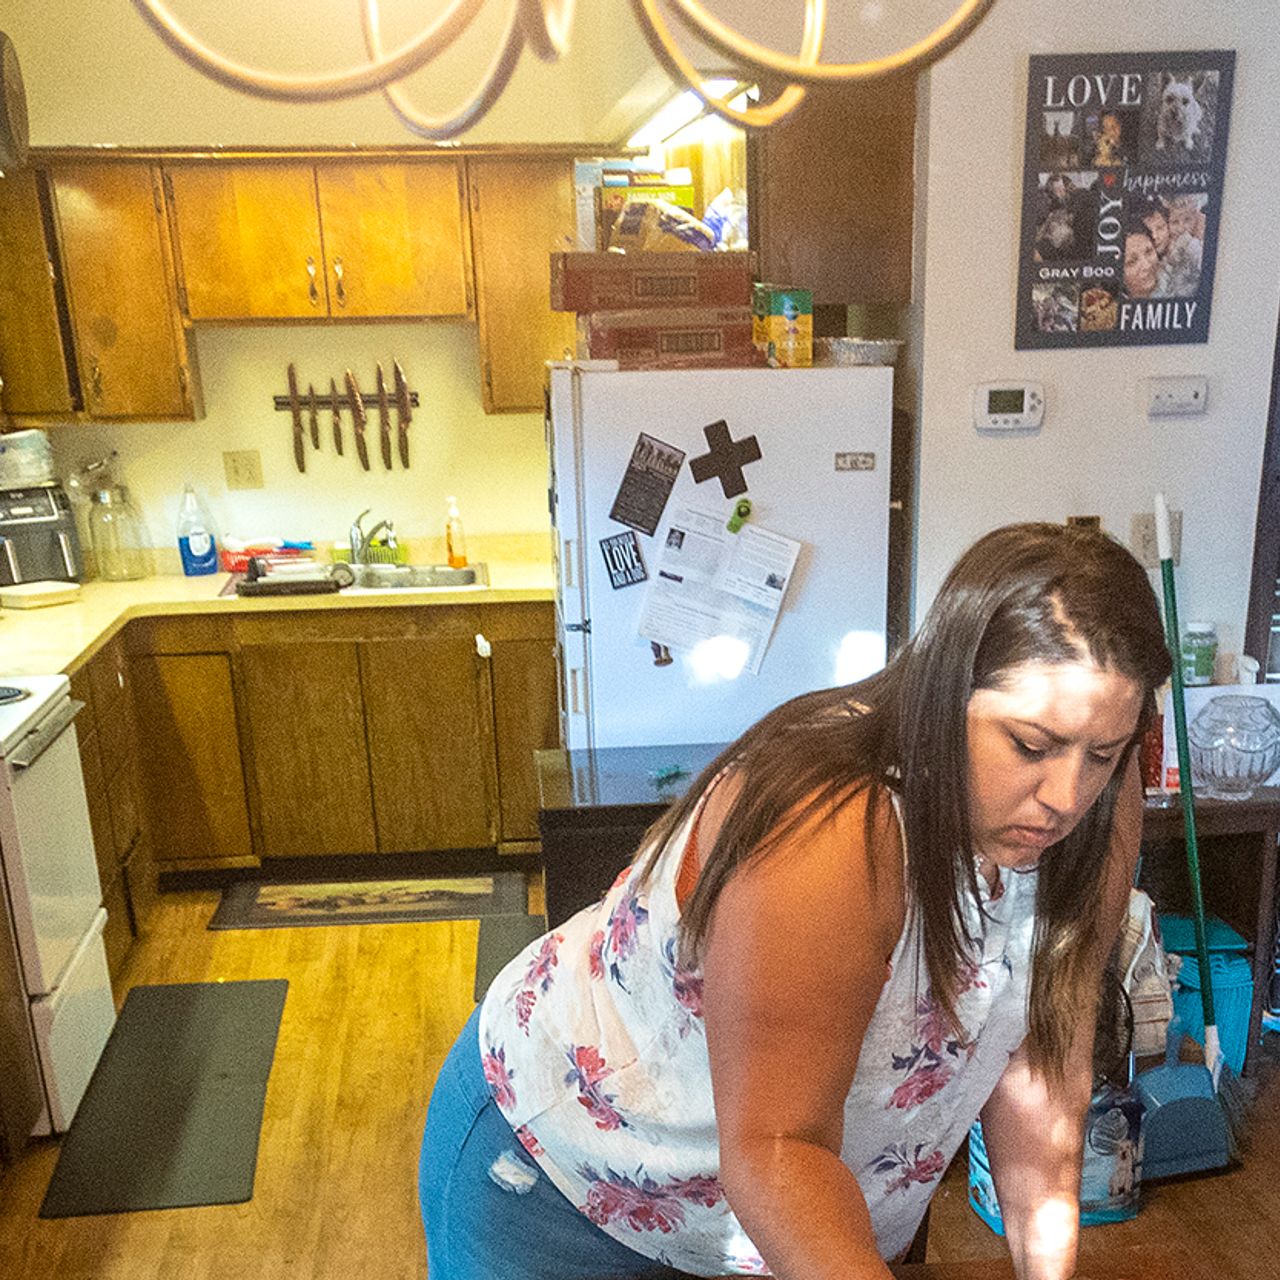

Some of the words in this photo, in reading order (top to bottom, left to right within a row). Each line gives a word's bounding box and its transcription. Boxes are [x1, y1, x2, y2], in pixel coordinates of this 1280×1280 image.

[1042, 73, 1142, 107] LOVE
[1122, 169, 1211, 193] happiness
[1096, 192, 1123, 260] JOY
[1120, 302, 1197, 332] FAMILY
[604, 542, 640, 574] LOVE
